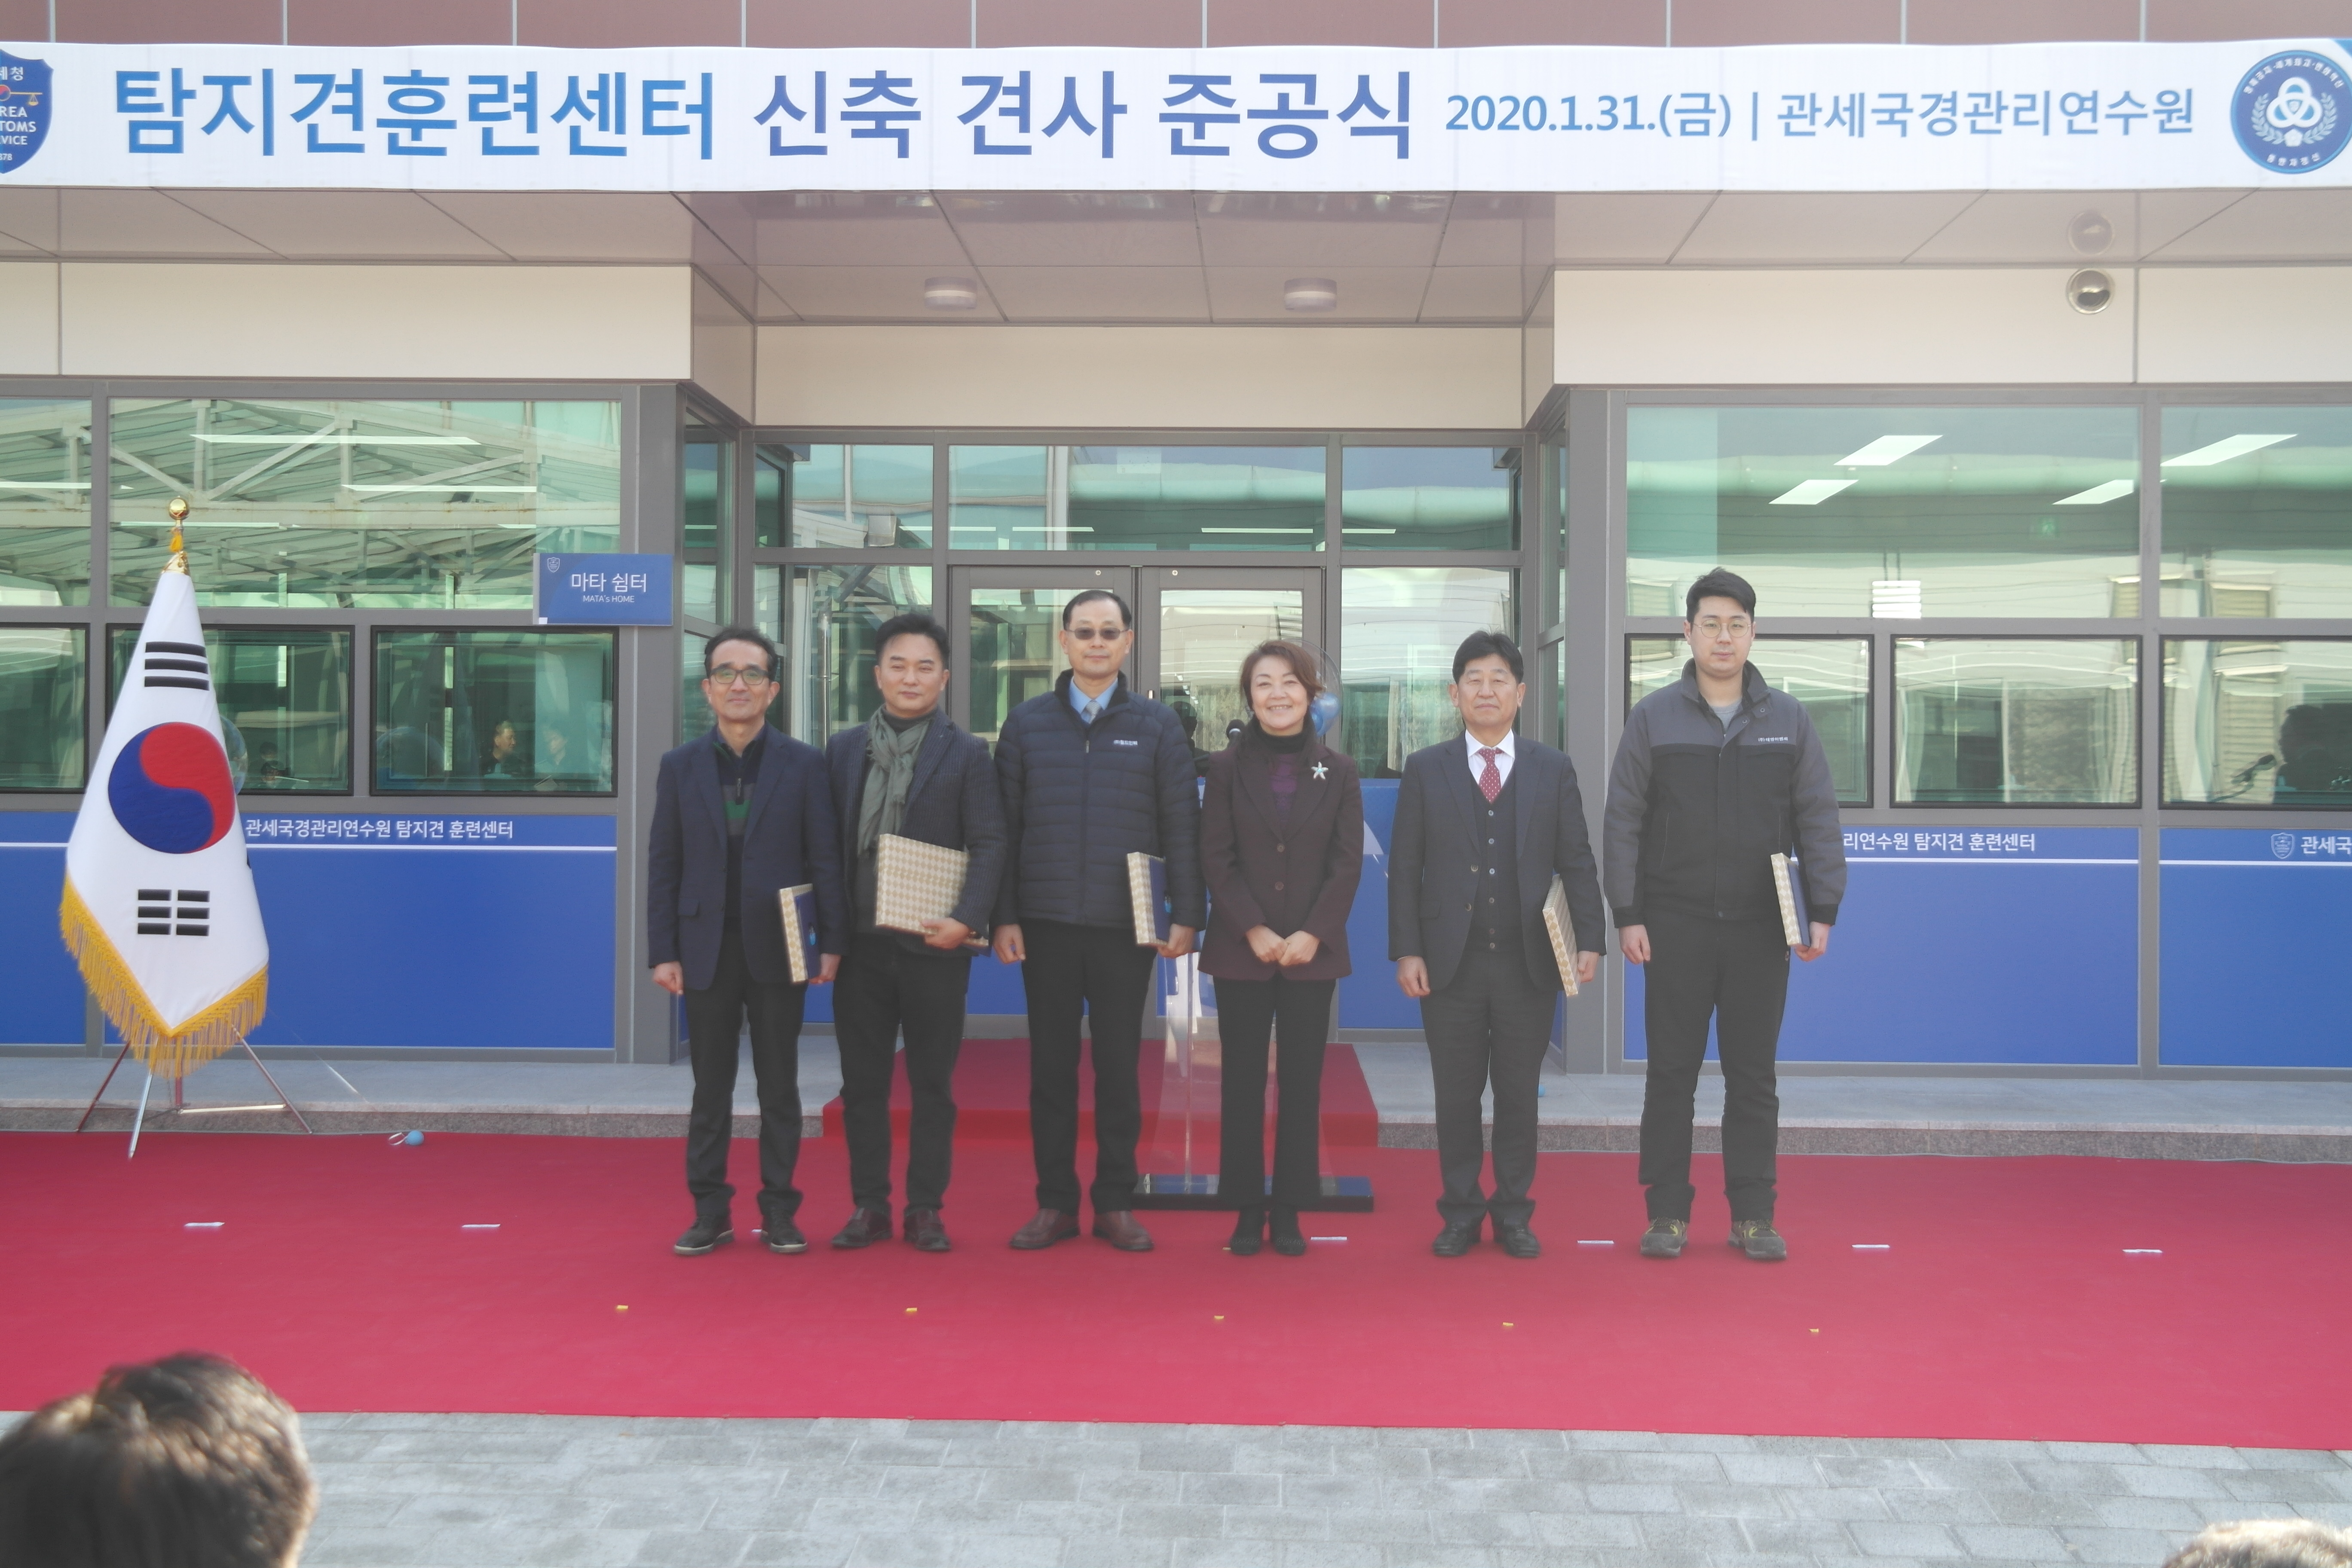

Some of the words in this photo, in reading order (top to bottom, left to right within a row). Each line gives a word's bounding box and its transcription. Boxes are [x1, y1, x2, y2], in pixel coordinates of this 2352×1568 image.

[115, 67, 714, 160] 탐지견훈련센터
[753, 70, 922, 159] 신축
[957, 70, 1128, 159] 견사
[1159, 71, 1411, 159] 준공식
[1445, 92, 1732, 139] 2020.1.31.(금)
[1776, 89, 2194, 138] 관세국경관리연수원
[0, 135, 28, 145] VICE
[571, 573, 607, 592] 마타
[612, 573, 647, 593] 쉼터
[245, 819, 391, 837] 관세국경관리연수원
[396, 820, 444, 838] 탐지견
[449, 821, 513, 839] 훈련센터
[1914, 833, 1963, 851] 탐지견
[1969, 833, 2036, 851] 훈련센터
[2301, 836, 2352, 855] 관세국
